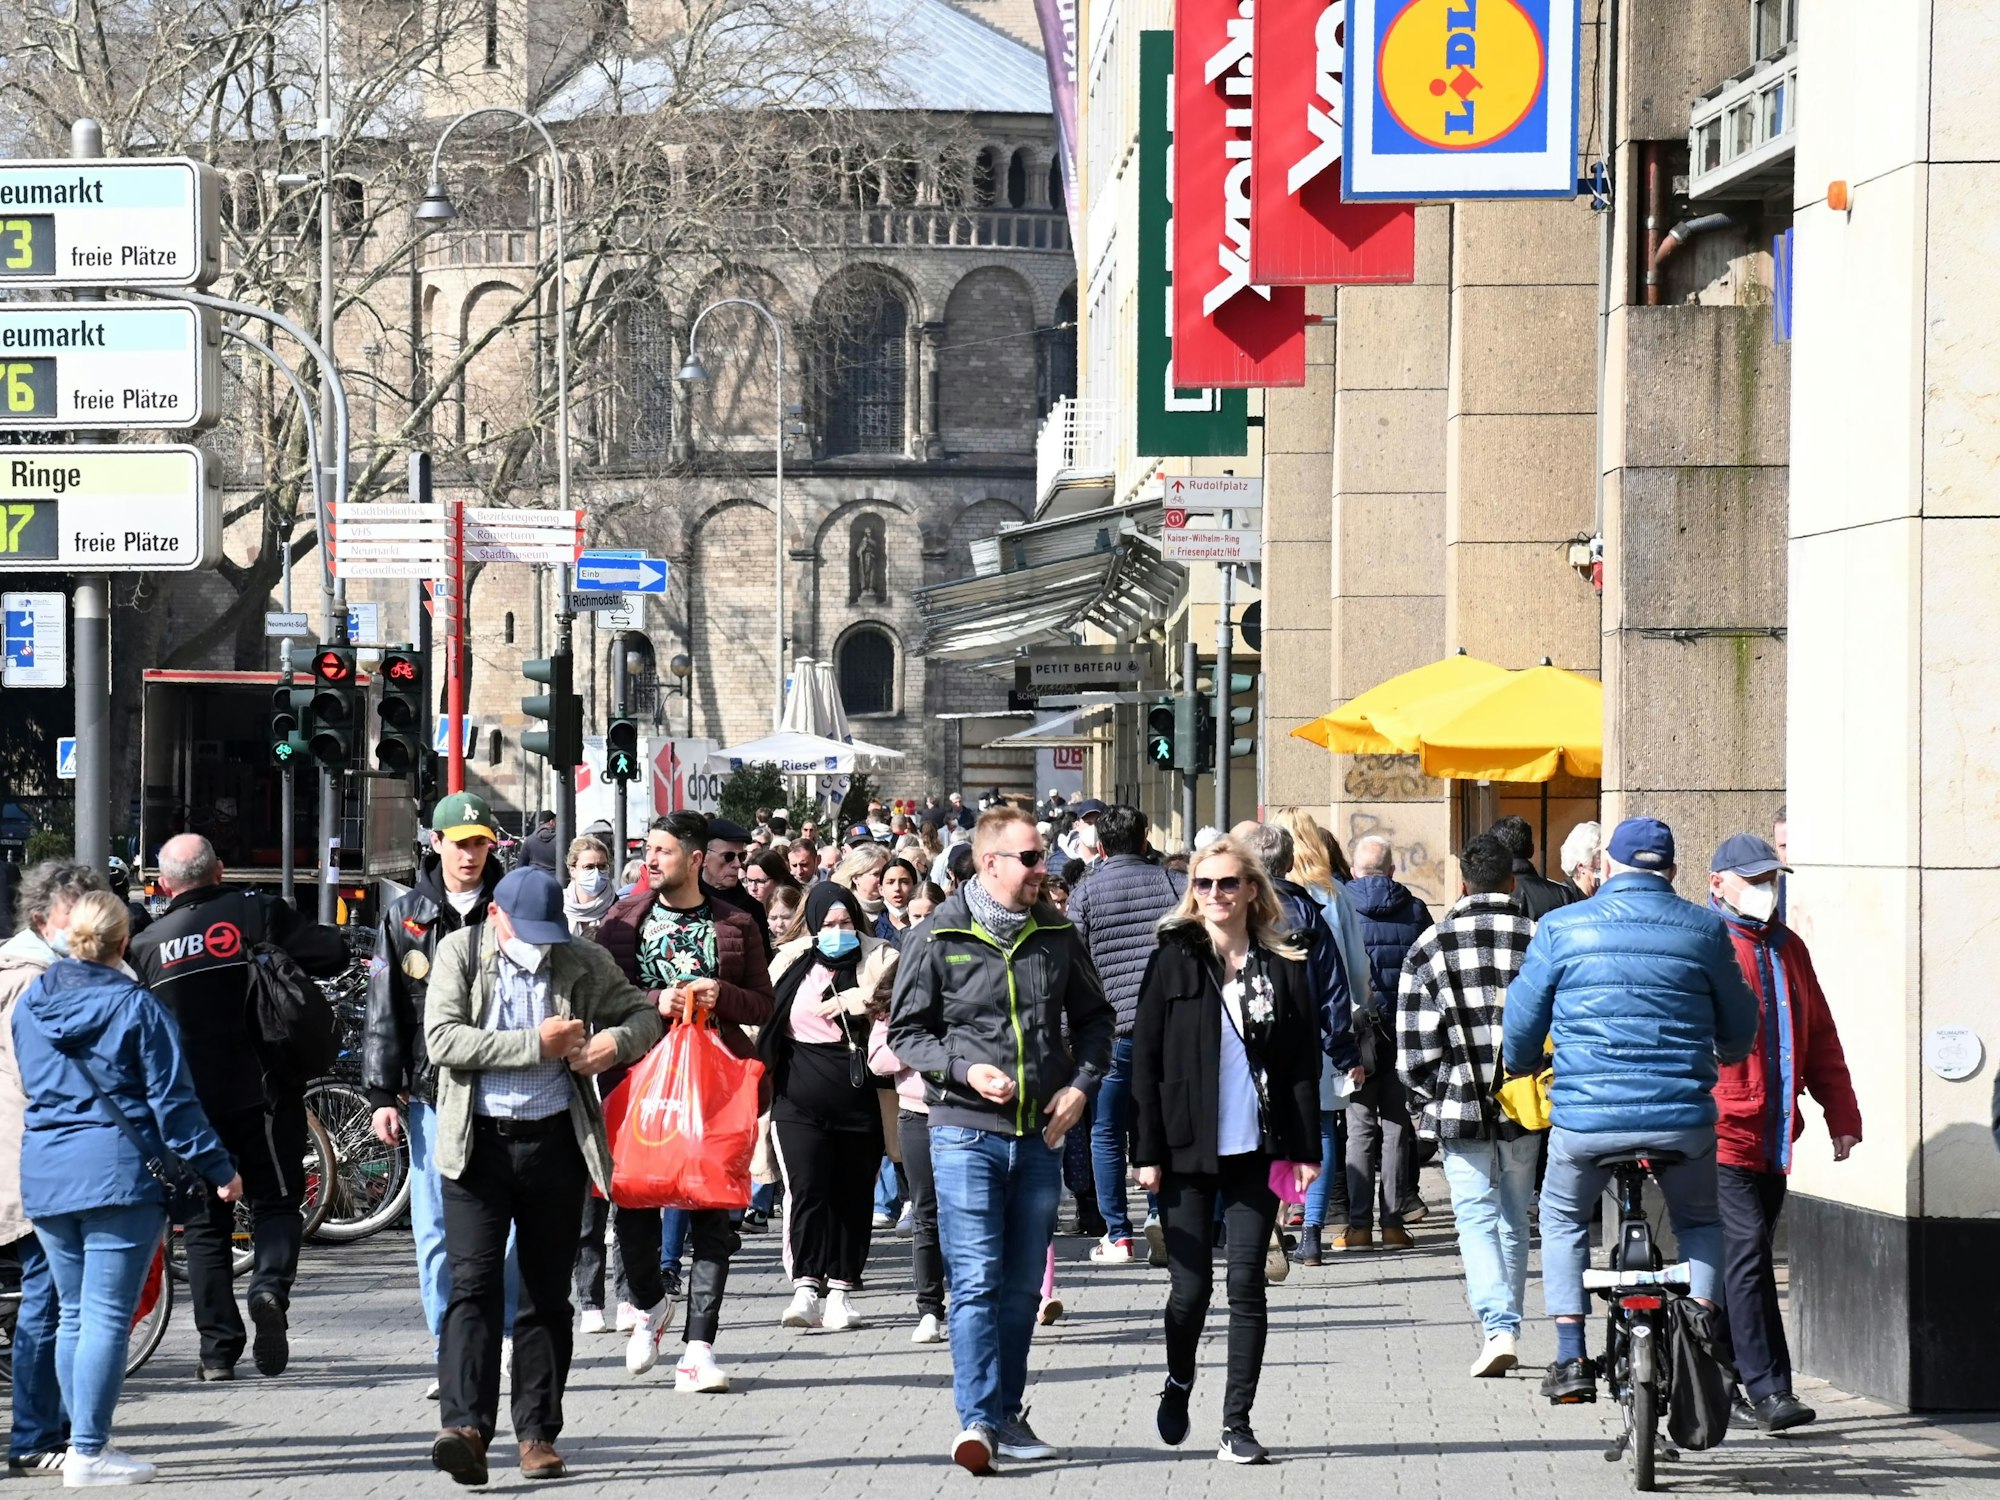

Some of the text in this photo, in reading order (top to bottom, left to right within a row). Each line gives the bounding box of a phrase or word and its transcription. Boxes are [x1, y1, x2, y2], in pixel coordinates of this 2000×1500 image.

[0, 219, 32, 269] 3
[71, 246, 177, 266] freie Plätze
[0, 363, 34, 412] 6
[73, 389, 179, 410] freie Plätze
[11, 460, 81, 493] Ringe
[1189, 480, 1248, 491] Rudolfplatz
[350, 506, 427, 516] Stadtbibliothek
[477, 511, 560, 524] Bezirksregierung
[351, 527, 372, 537] VHS
[477, 529, 535, 540] Römerturm
[75, 532, 179, 552] freie Plätze
[1167, 534, 1240, 544] Kaiser-Wilhelm-Ring
[350, 545, 400, 555] Neumarkt
[480, 549, 549, 559] Stadtmuseum
[1177, 547, 1240, 557] Friesenplatz/Hbf
[350, 565, 432, 575] Gesundheitsamt
[573, 592, 622, 608] Richmodstr.
[267, 620, 307, 628] Neumarkt-Süd
[1036, 661, 1121, 674] PETIT BATEAU
[782, 760, 817, 770] Riese
[160, 934, 204, 964] KVB
